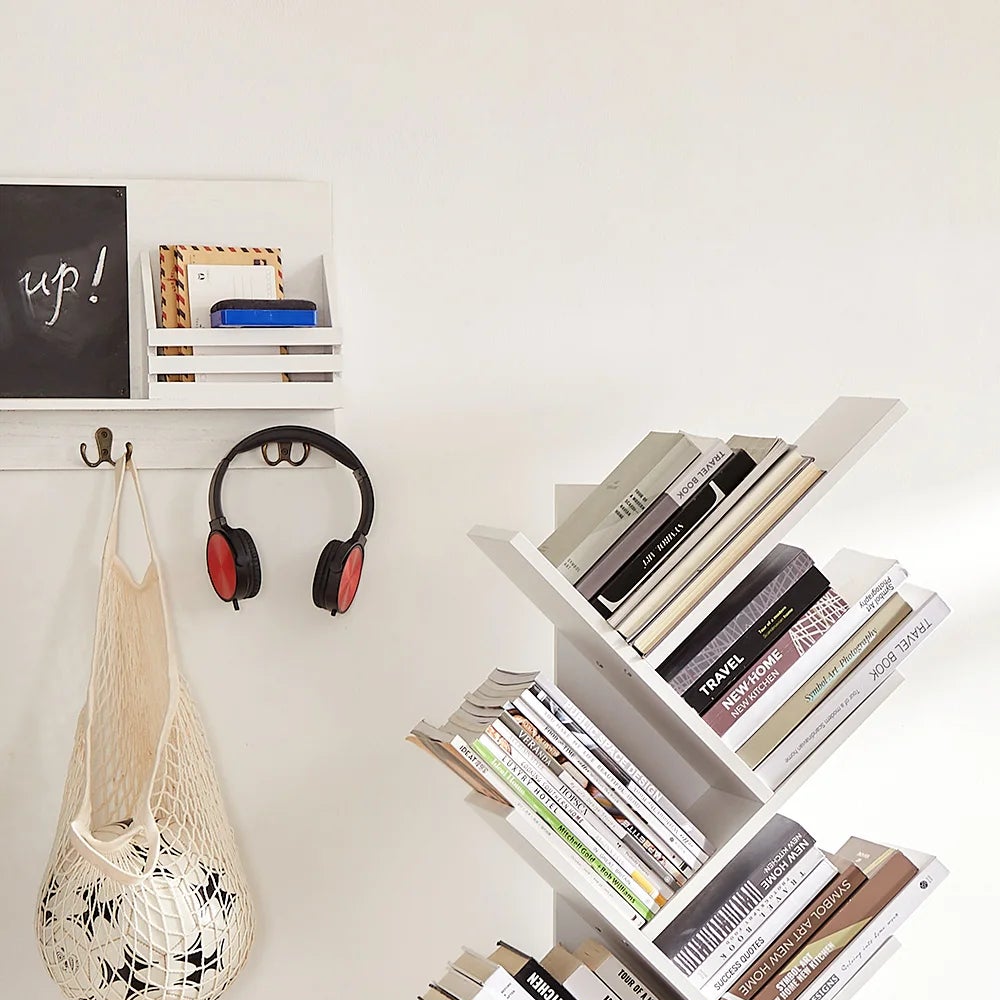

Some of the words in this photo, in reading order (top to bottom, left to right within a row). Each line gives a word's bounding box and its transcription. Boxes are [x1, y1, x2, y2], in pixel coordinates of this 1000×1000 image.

[19, 245, 107, 326] up!
[696, 449, 726, 479] TRAVEL
[675, 475, 699, 499] BOOK
[654, 521, 685, 552] SYMBOL
[638, 550, 657, 569] ART
[856, 573, 892, 610] Photography
[864, 600, 877, 613] Art
[872, 580, 895, 604] Symbol
[893, 615, 932, 655] TRAVEL
[697, 649, 746, 699] TRAVEL
[720, 679, 752, 711] NEW
[746, 646, 784, 686] HOME
[866, 649, 899, 682] BOOK
[729, 697, 751, 719] NEW
[747, 667, 781, 701] KITCHEN
[516, 729, 554, 767] VERANDA
[562, 700, 599, 737] PUBLIC
[594, 733, 629, 768] SPACE
[625, 763, 663, 802] DESIGN
[532, 786, 560, 814] HOTEL
[784, 837, 810, 863] NEW
[785, 831, 802, 849] NEW
[556, 823, 583, 851] Mitchell
[579, 846, 596, 864] Gold
[610, 877, 637, 905] Williams
[758, 858, 789, 891] HOME
[762, 845, 789, 873] KITCHEN
[757, 868, 806, 920] TRAVEL
[808, 876, 852, 922] SYMBOL
[718, 925, 753, 962] BOOK
[789, 916, 815, 943] ART
[712, 959, 743, 991] SUCCESS
[738, 935, 766, 964] QUOTES
[766, 937, 795, 966] NEW
[778, 977, 801, 1000] HOME
[795, 964, 813, 983] NEW
[807, 940, 837, 971] KITCHEN
[616, 968, 636, 988] TOUR
[631, 983, 644, 996] OF
[639, 991, 649, 1000] A
[736, 961, 771, 998] HOME
[773, 963, 803, 993] SYMBOL
[797, 950, 814, 968] ART
